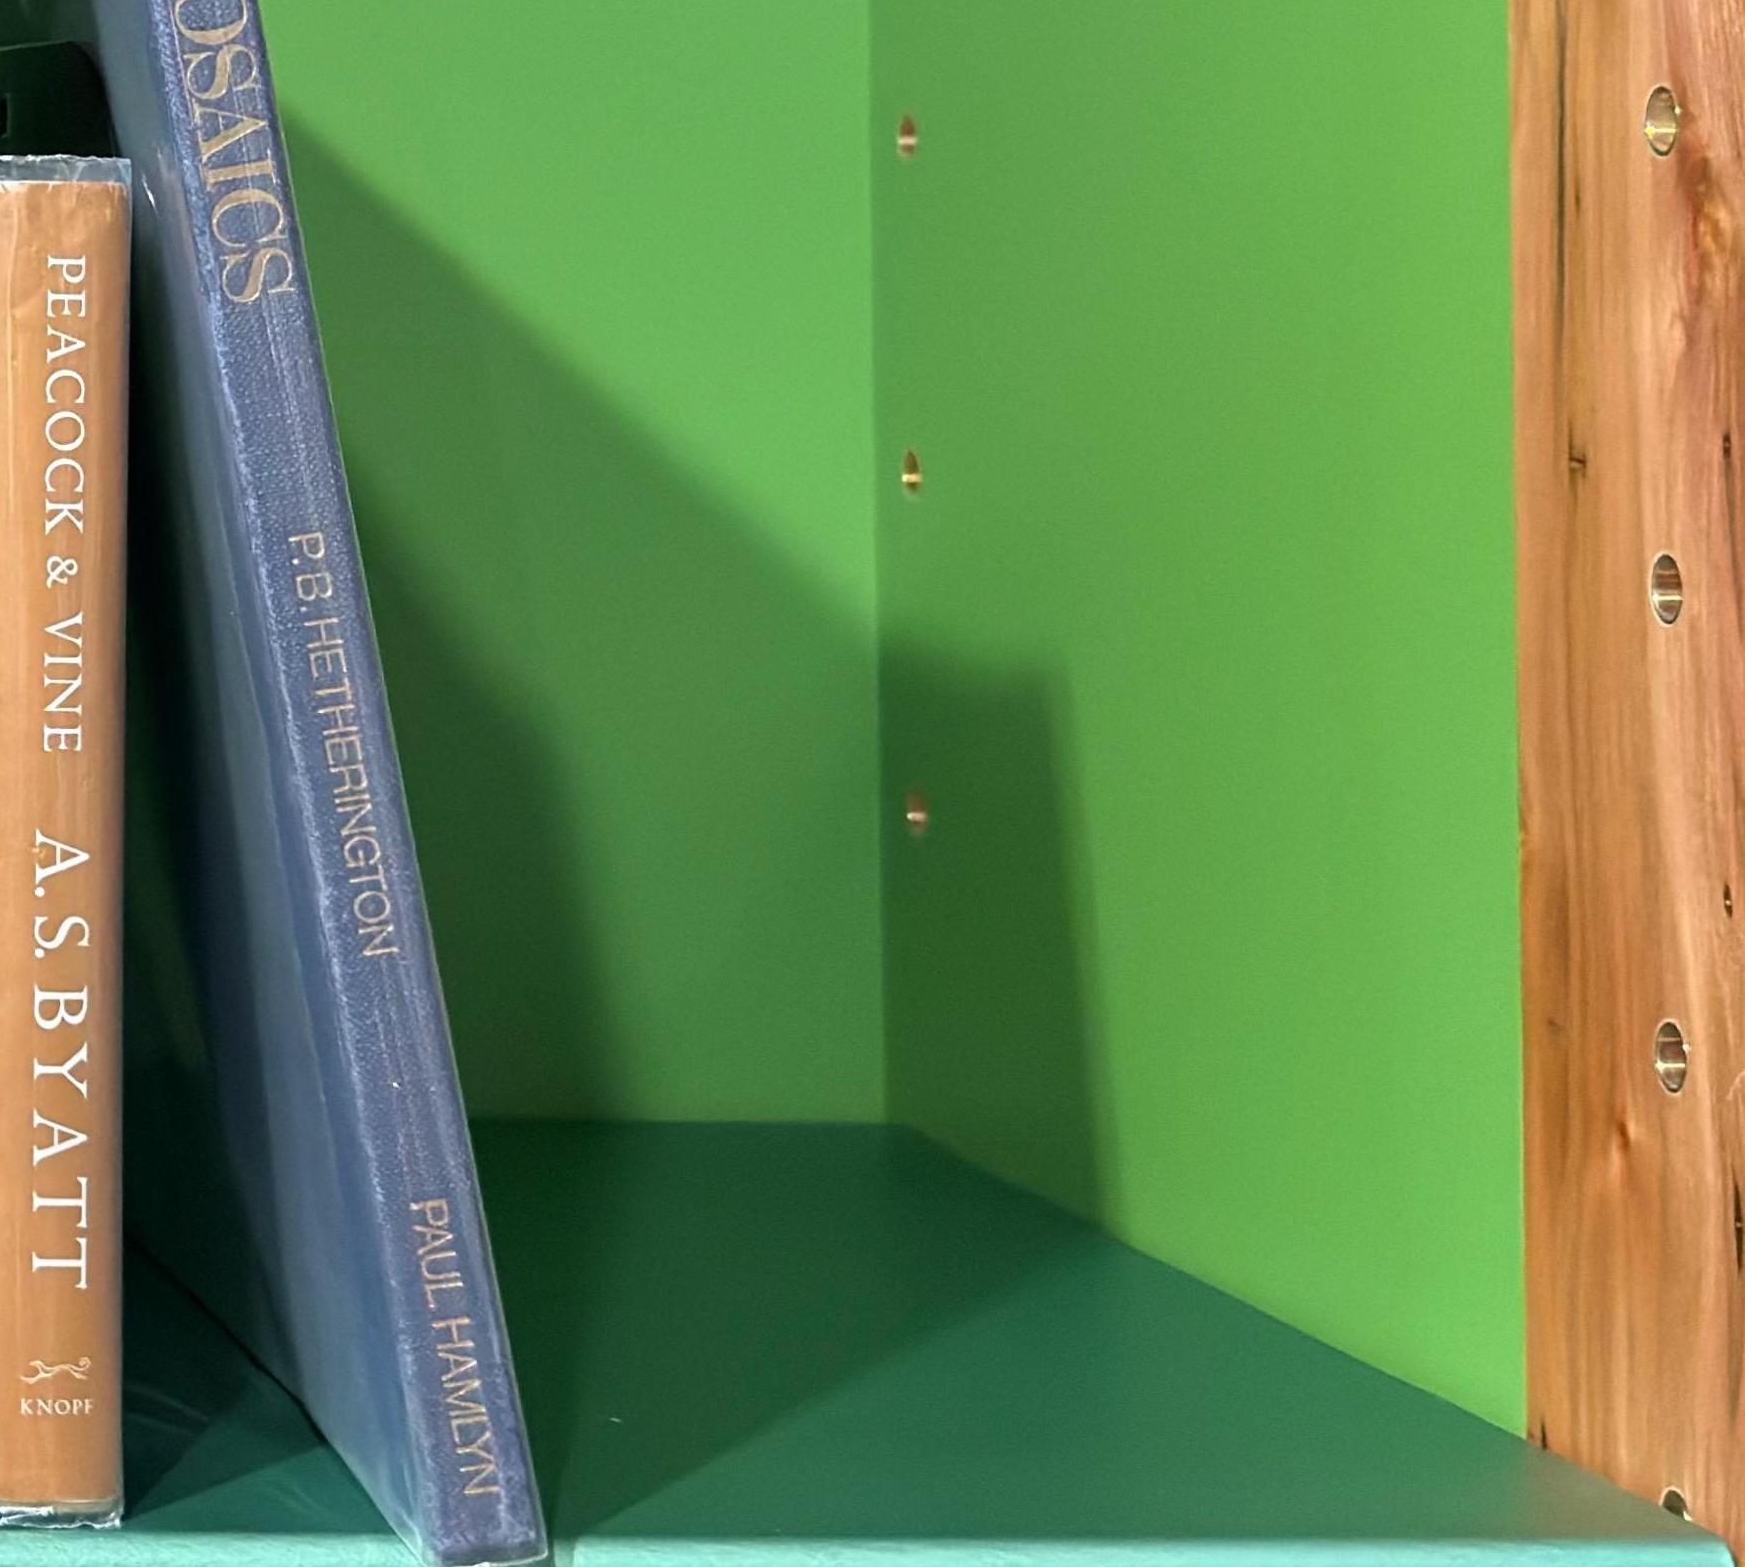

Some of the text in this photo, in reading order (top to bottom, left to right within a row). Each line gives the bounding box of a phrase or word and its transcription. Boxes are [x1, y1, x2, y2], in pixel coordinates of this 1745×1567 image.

[32, 255, 89, 1290] PEACOCK VINE BYATT
[18, 1397, 94, 1417] KNOPF
[409, 1198, 503, 1496] PAUL HAMLYN
